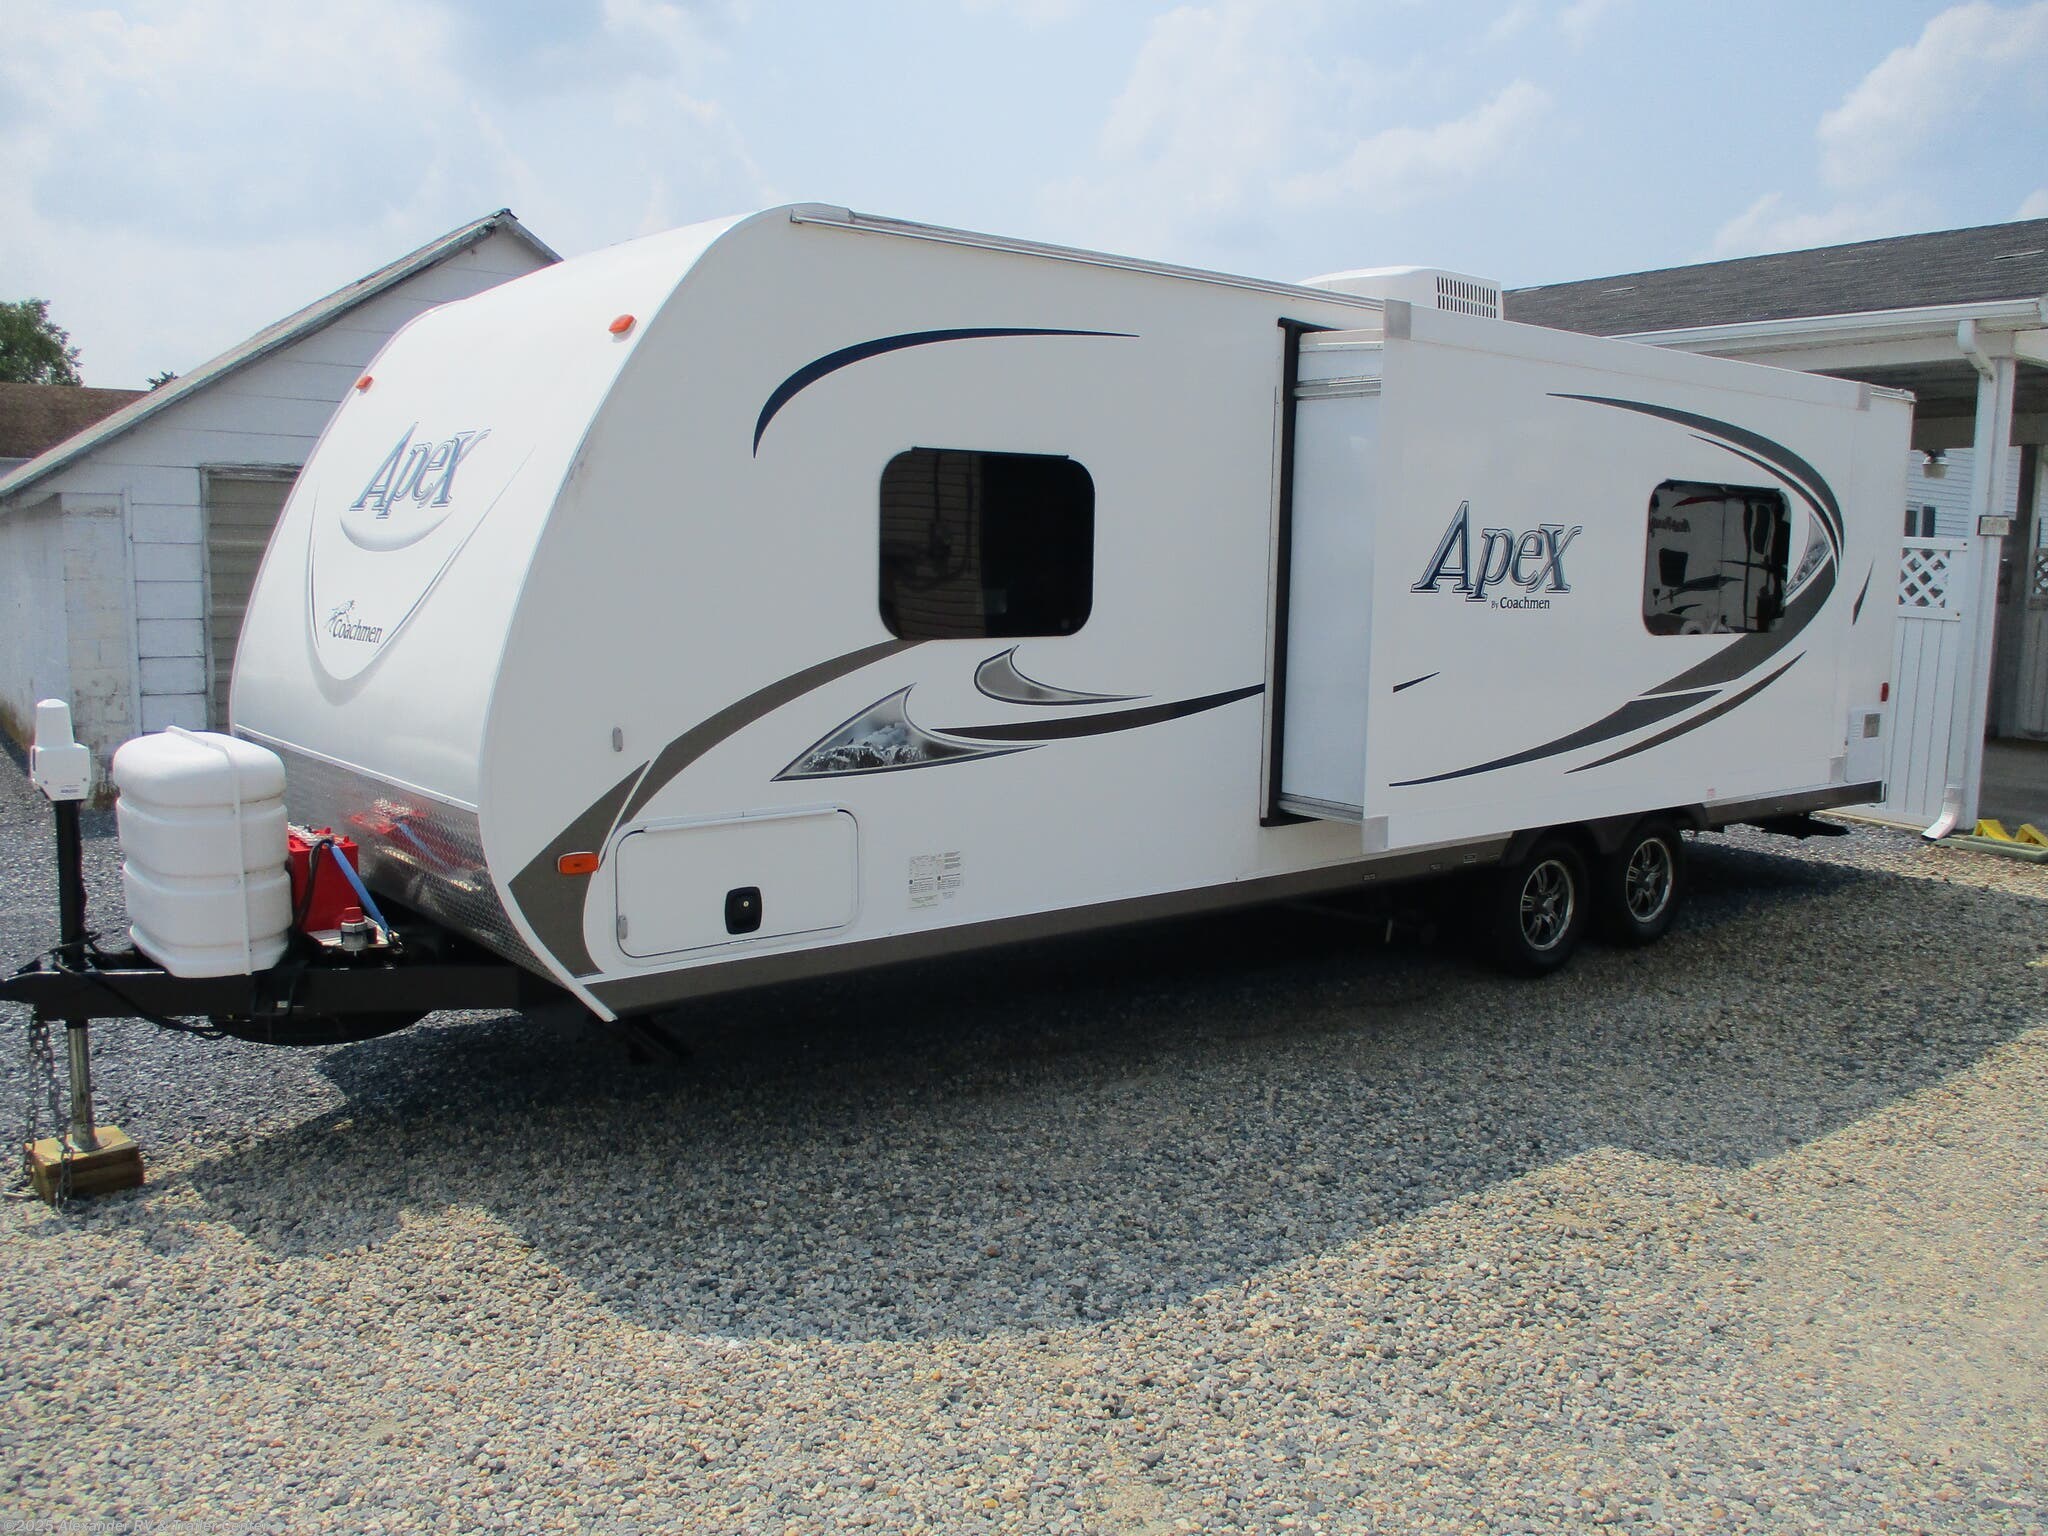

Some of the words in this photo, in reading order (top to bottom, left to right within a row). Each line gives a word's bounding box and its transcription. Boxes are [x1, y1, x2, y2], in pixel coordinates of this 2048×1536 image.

[349, 420, 492, 519] Apex
[1410, 500, 1583, 602] Apex
[333, 619, 383, 643] Coachmen
[1500, 596, 1550, 609] Coachmen
